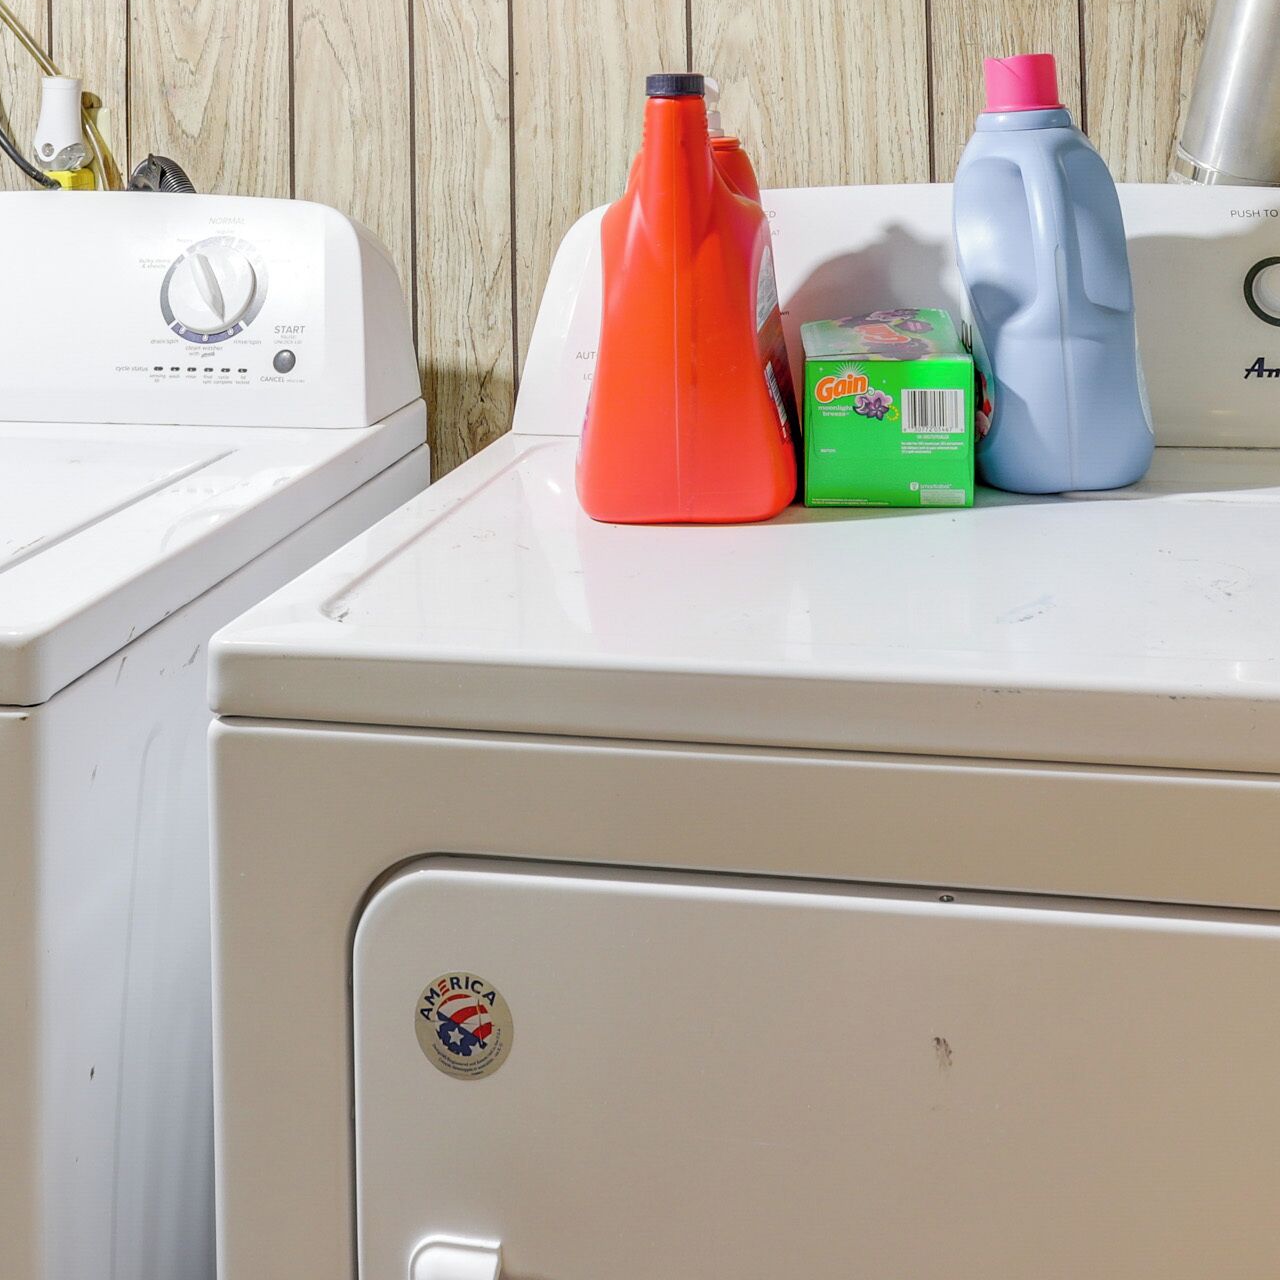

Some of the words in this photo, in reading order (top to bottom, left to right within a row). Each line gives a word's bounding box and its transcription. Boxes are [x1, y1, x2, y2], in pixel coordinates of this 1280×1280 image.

[1230, 210, 1261, 218] PUSH
[1263, 209, 1279, 217] TO
[208, 217, 246, 225] NORMAL
[274, 325, 306, 334] START
[815, 373, 869, 404] Gain
[420, 976, 496, 1021] AMERICA
